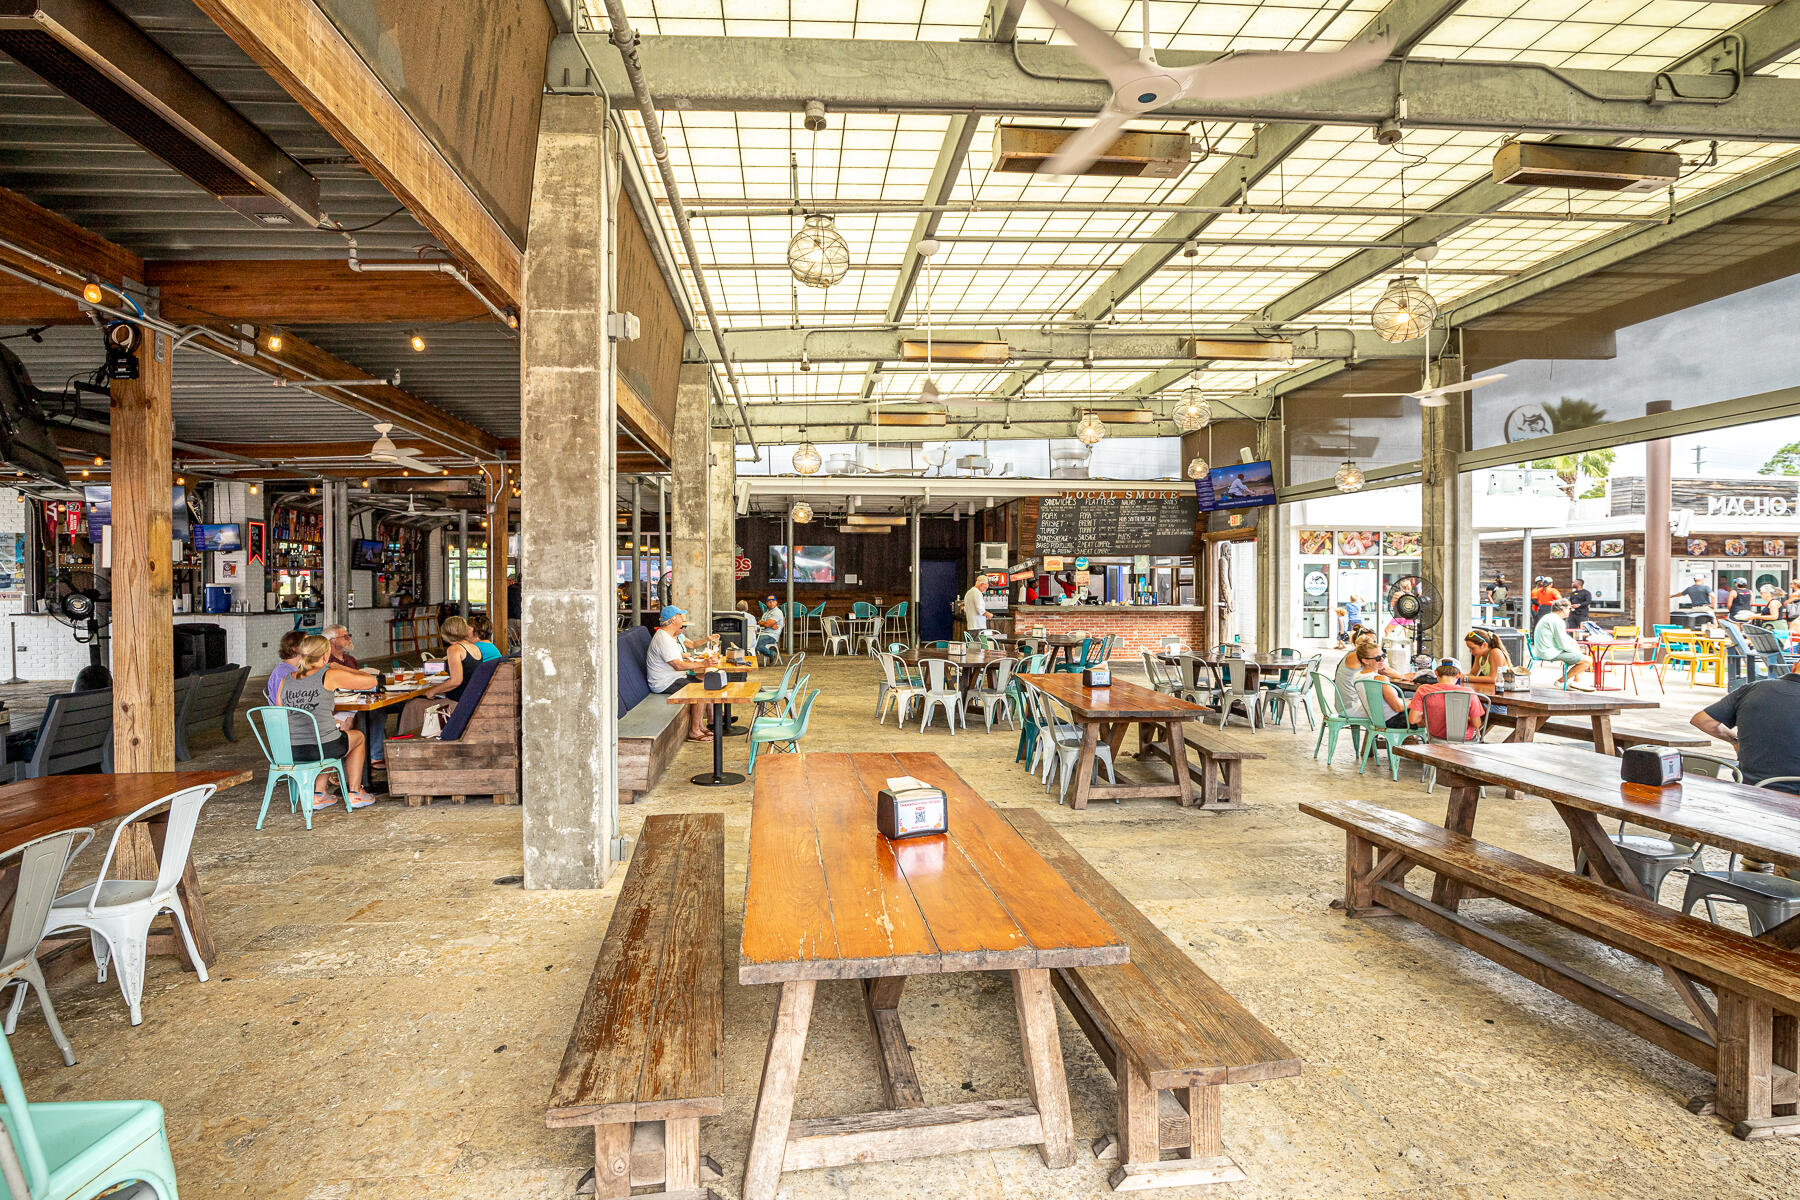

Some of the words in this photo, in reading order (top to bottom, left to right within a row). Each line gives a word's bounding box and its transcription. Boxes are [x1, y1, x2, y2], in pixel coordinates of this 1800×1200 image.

[1065, 491, 1117, 499] LOCAL
[1125, 491, 1178, 499] SMOKE
[1043, 498, 1077, 506] SANDWICHES
[1707, 496, 1788, 516] MACHO
[46, 502, 58, 522] VT
[1041, 520, 1066, 528] BRISKET
